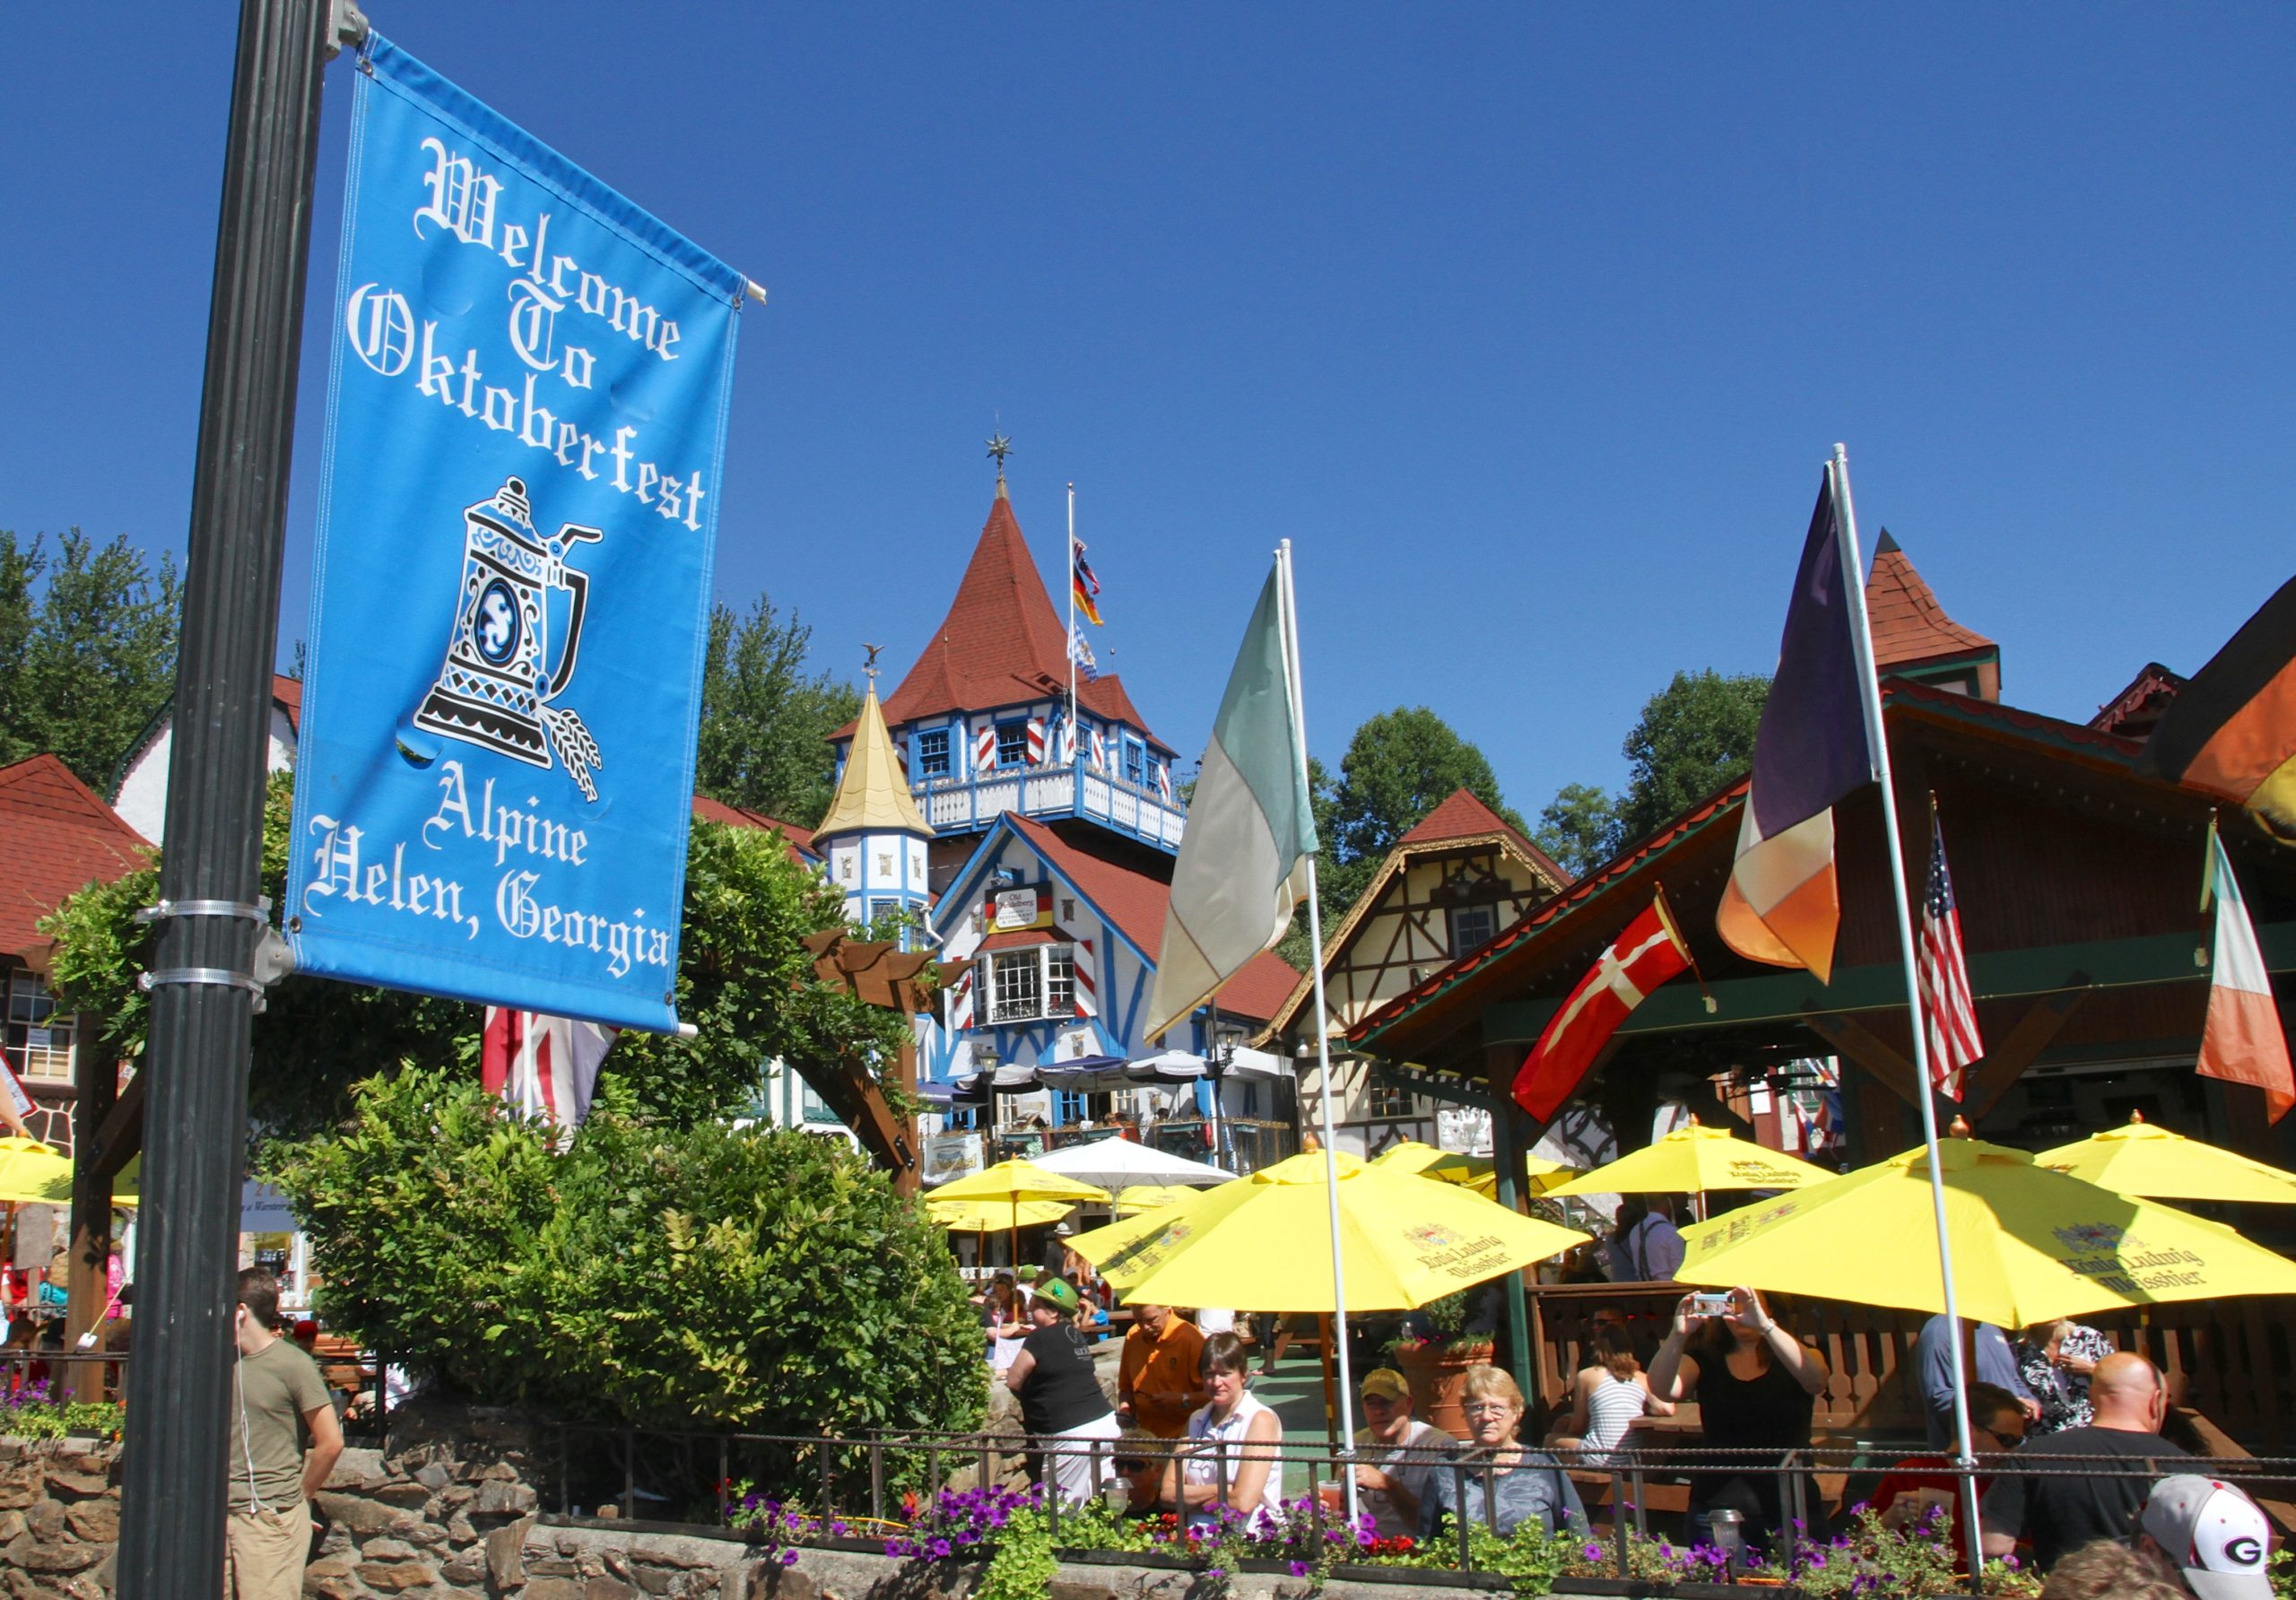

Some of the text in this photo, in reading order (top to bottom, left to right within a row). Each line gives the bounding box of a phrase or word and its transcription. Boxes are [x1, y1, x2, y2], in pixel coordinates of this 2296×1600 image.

[413, 137, 680, 361] Welcome
[508, 279, 596, 389] To
[347, 283, 705, 531] Oktoberfest
[422, 760, 588, 866] Alpine
[304, 814, 672, 978] Helen, Georgia
[2116, 1248, 2205, 1268] Ludwig
[2223, 1536, 2262, 1566] G
